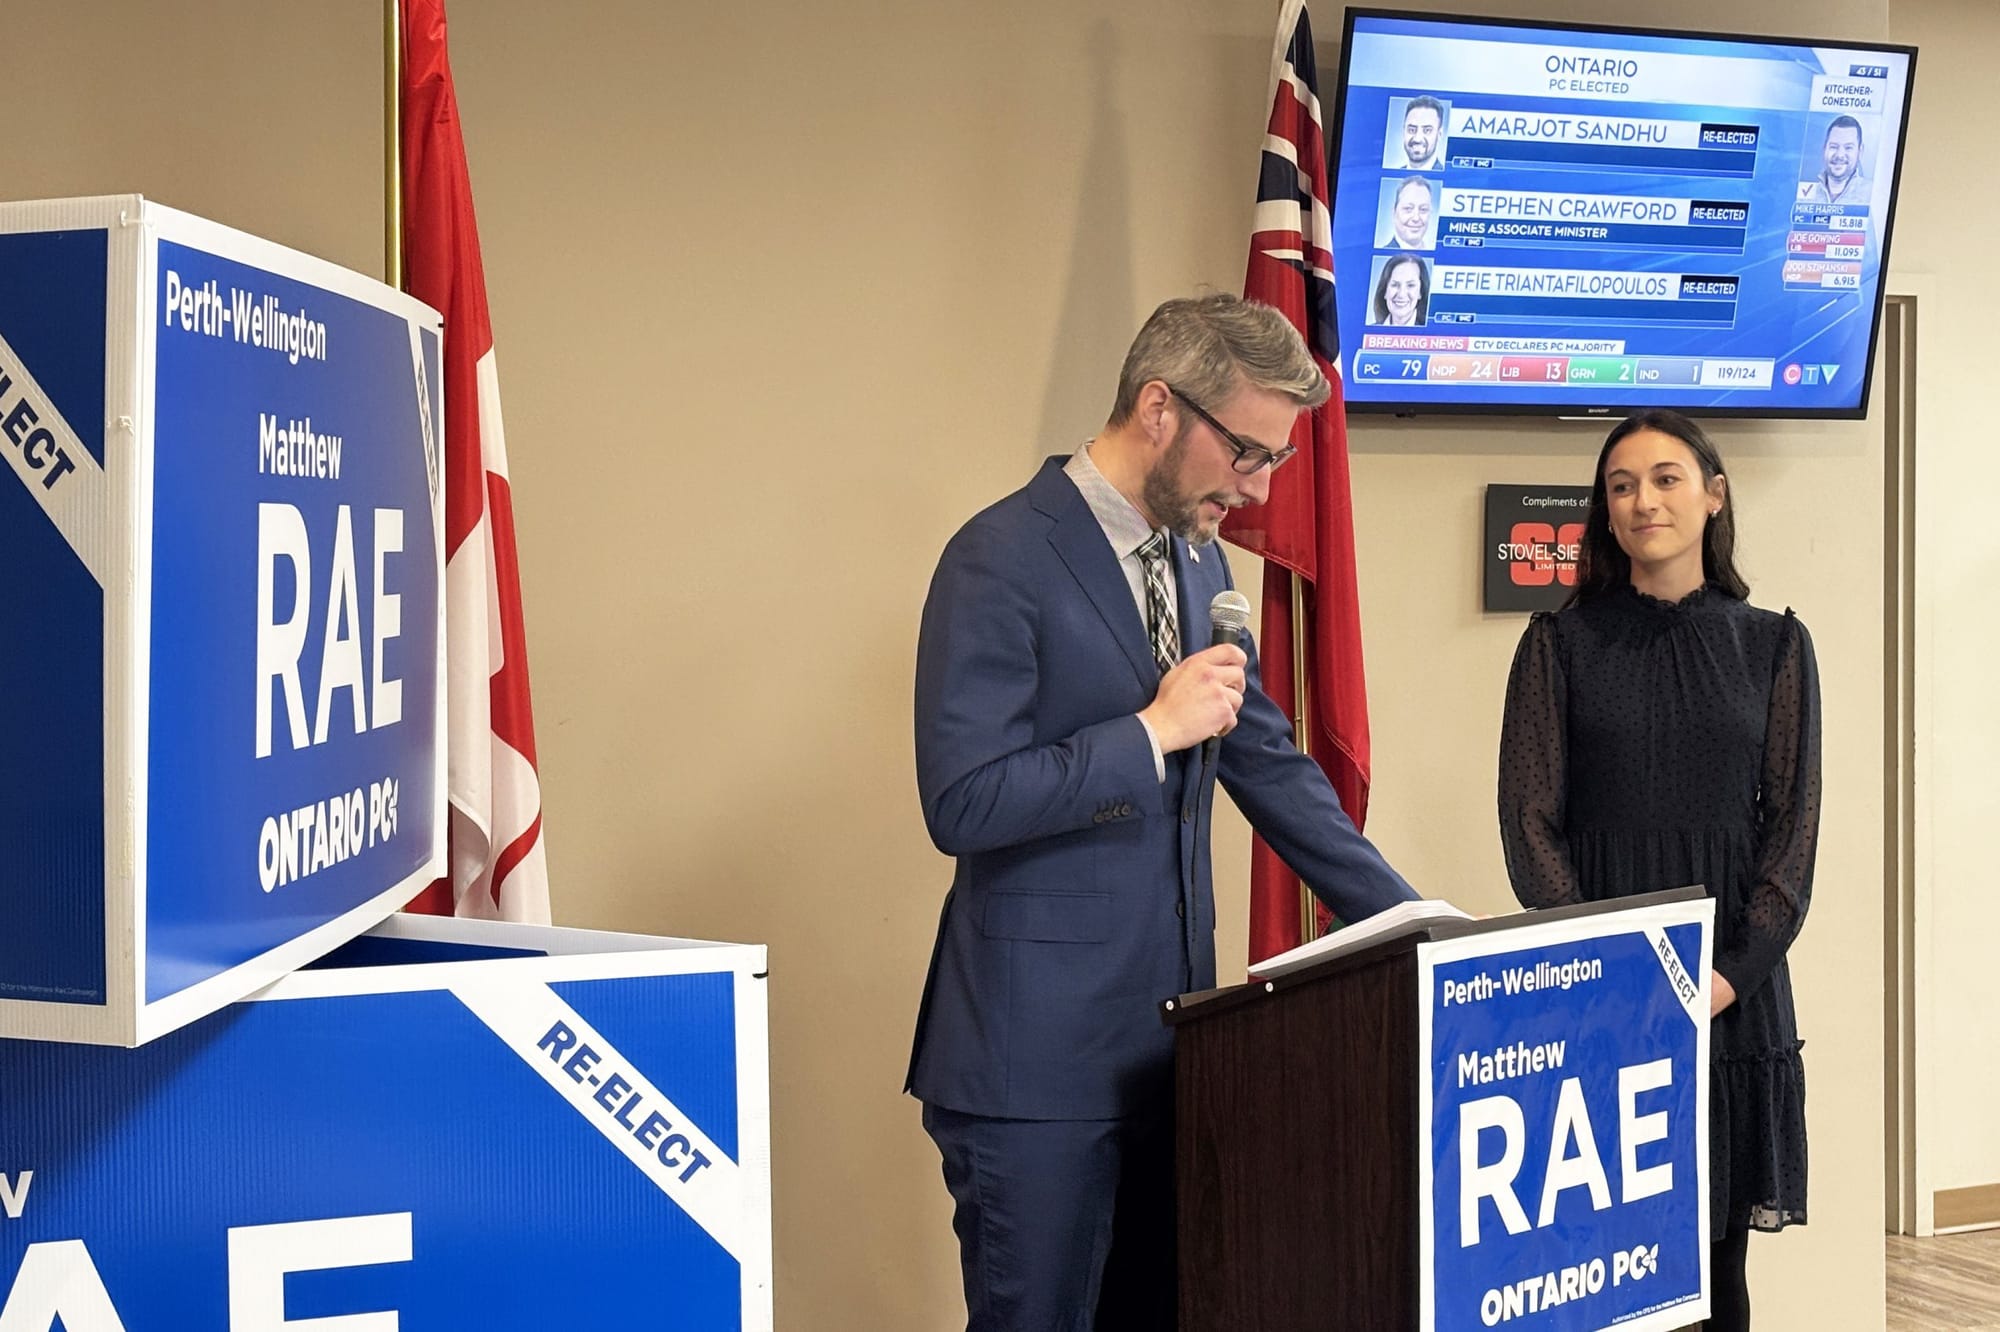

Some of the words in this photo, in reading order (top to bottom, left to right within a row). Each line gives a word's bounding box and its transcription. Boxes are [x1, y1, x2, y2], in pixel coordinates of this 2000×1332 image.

[1545, 55, 1638, 78] ONTARIO
[1549, 79, 1566, 91] PC
[1570, 80, 1629, 94] ELECTED
[1824, 84, 1873, 96] KITCHENER-
[1822, 96, 1872, 108] CONESTOGA
[1461, 115, 1572, 138] AMARJOT
[1576, 121, 1668, 143] SANDHU
[1703, 130, 1756, 144] RE-ELECTED
[1452, 194, 1552, 216] STEPHEN
[1558, 199, 1677, 221] CRAWFORD
[1693, 208, 1746, 221] RE-ELECTED
[1449, 222, 1486, 234] MINES
[1488, 224, 1552, 237] ASSOCIATE
[1554, 226, 1608, 238] MINISTER
[1443, 272, 1490, 290] EFFIE
[1496, 273, 1667, 296] TRIANTAFILOPOULOS
[1683, 283, 1736, 295] RE-ELECTED
[166, 270, 326, 365] Perth-Wellington
[1368, 337, 1427, 348] BREAKING
[1430, 338, 1464, 350] NEWS
[1474, 340, 1494, 350] CTV
[1496, 341, 1548, 351] DECLARES
[1551, 342, 1564, 351] PC
[1565, 343, 1616, 352] MAJORITY
[1364, 364, 1380, 374] PC
[1401, 360, 1421, 377] 79
[1432, 367, 1456, 376] NDP
[1470, 361, 1492, 378] 24
[1502, 368, 1520, 377] LIB
[1546, 363, 1561, 380] 13
[1570, 368, 1596, 379] GRN
[1619, 364, 1629, 381] 2
[1639, 369, 1659, 380] IND
[1692, 365, 1698, 382] 1
[1718, 367, 1756, 379] 119/124
[259, 412, 342, 479] Matthew
[1522, 496, 1577, 508] Compliments
[1579, 497, 1589, 507] of
[1498, 544, 1580, 561] STOVEL-SIE
[255, 502, 404, 759] RAE
[258, 787, 365, 894] ONTARIO
[369, 777, 392, 848] PC
[1658, 938, 1696, 1004] RE-ELECT
[1444, 958, 1602, 1007] Perth-Wellington
[1458, 1040, 1566, 1088] Matthew
[536, 1019, 712, 1184] RE-ELECT
[1459, 1057, 1673, 1248] RAE
[1480, 1258, 1605, 1327] ONTARIO
[1613, 1245, 1646, 1287] PC
